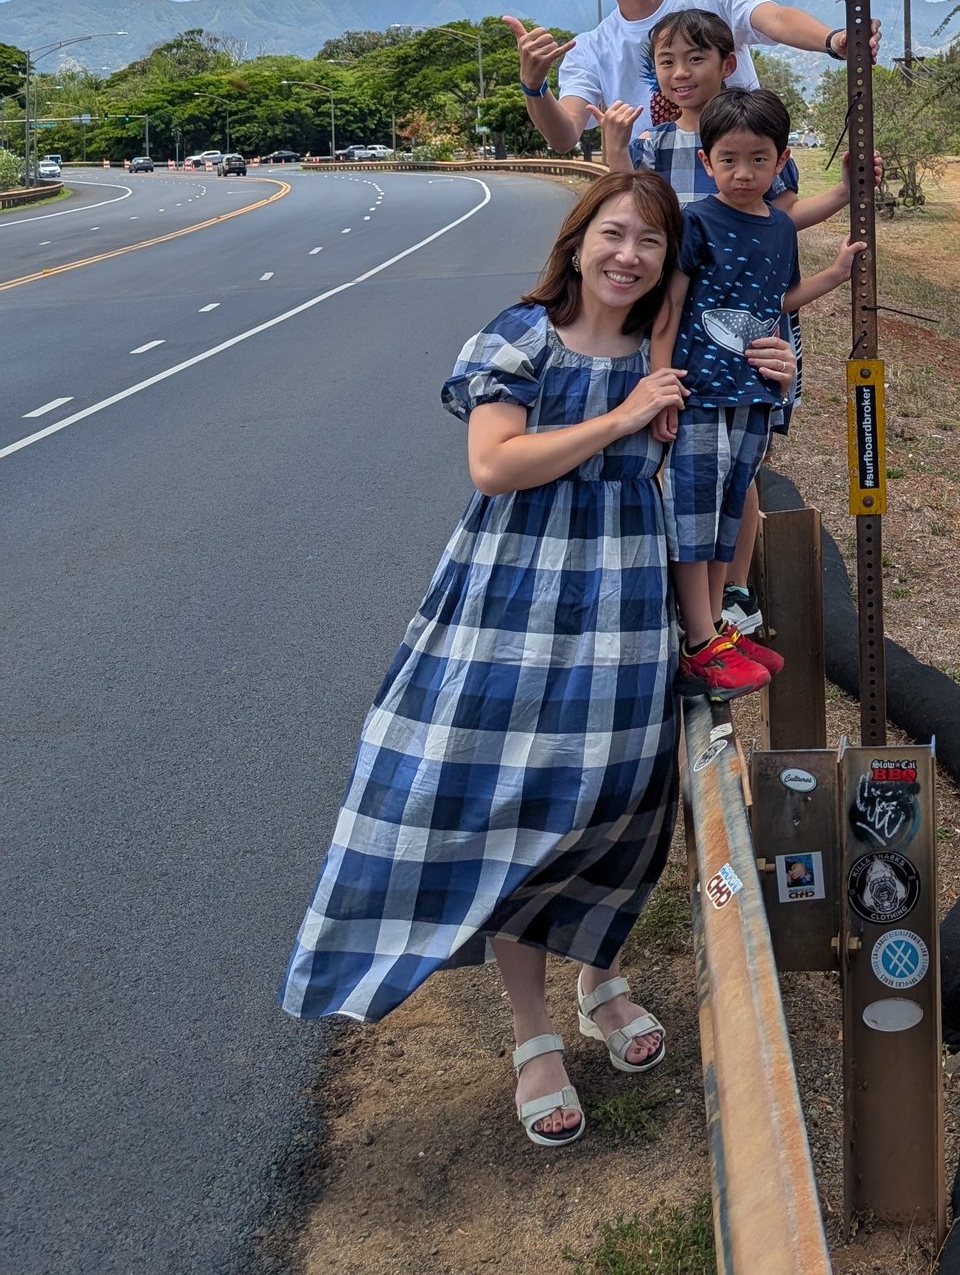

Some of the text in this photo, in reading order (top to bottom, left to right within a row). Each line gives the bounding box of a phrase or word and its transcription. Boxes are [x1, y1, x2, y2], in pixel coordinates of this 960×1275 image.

[862, 387, 875, 487] #surfboardbroker
[873, 769, 917, 783] BBQ
[852, 853, 906, 877] KILLA SHARKS
[870, 905, 908, 921] CLOTHING
